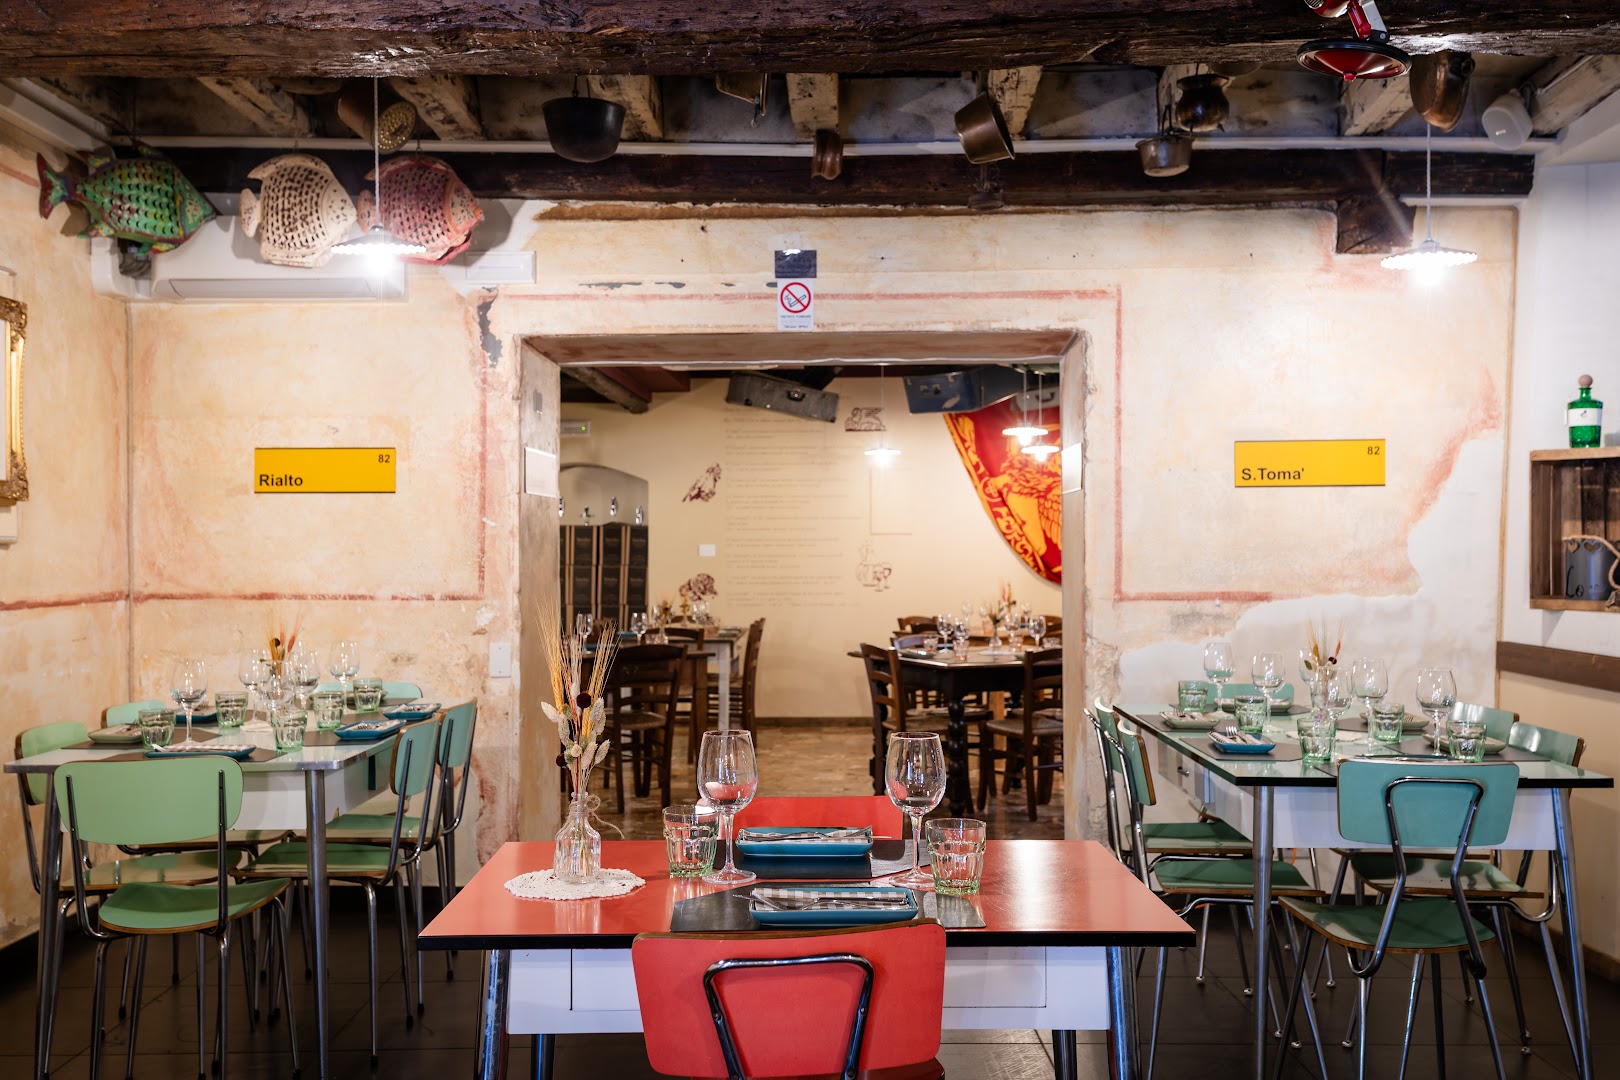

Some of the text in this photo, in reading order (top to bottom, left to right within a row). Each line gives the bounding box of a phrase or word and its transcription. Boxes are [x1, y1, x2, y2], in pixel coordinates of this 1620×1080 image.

[1367, 446, 1380, 455] 82
[378, 454, 391, 464] 82
[1241, 467, 1305, 481] S.Toma'
[259, 474, 303, 487] Rialto
